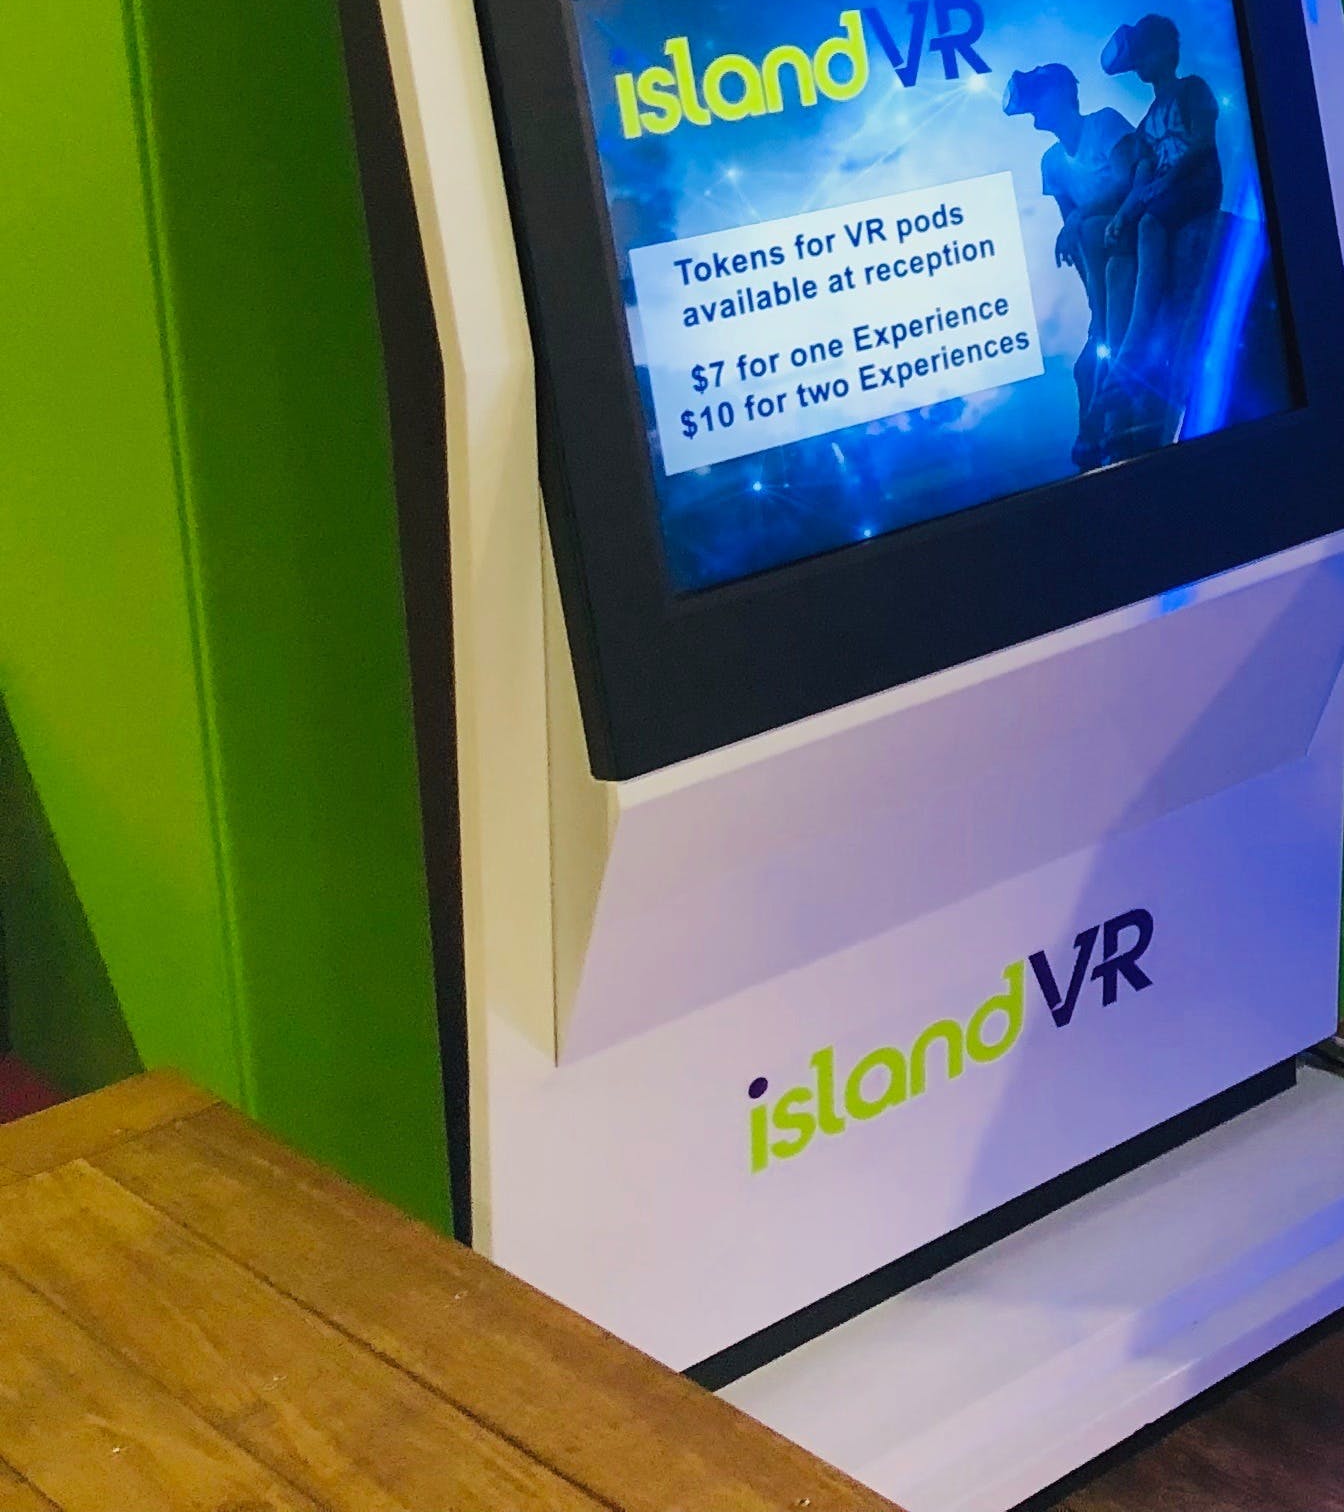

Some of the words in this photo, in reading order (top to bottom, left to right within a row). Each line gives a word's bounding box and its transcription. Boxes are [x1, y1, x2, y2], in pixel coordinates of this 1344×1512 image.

[674, 244, 785, 287] Tokens
[794, 233, 836, 260] for
[843, 217, 888, 248] VR
[896, 203, 964, 244] pods
[683, 277, 818, 328] available
[828, 266, 856, 294] at
[864, 238, 996, 285] reception
[680, 400, 735, 440] $10
[744, 392, 787, 421] for
[797, 378, 849, 409] two
[858, 330, 1031, 391] Experiences
[691, 361, 725, 394] $7
[736, 352, 781, 381] for
[790, 338, 844, 368] one
[853, 297, 1010, 352] Experience
